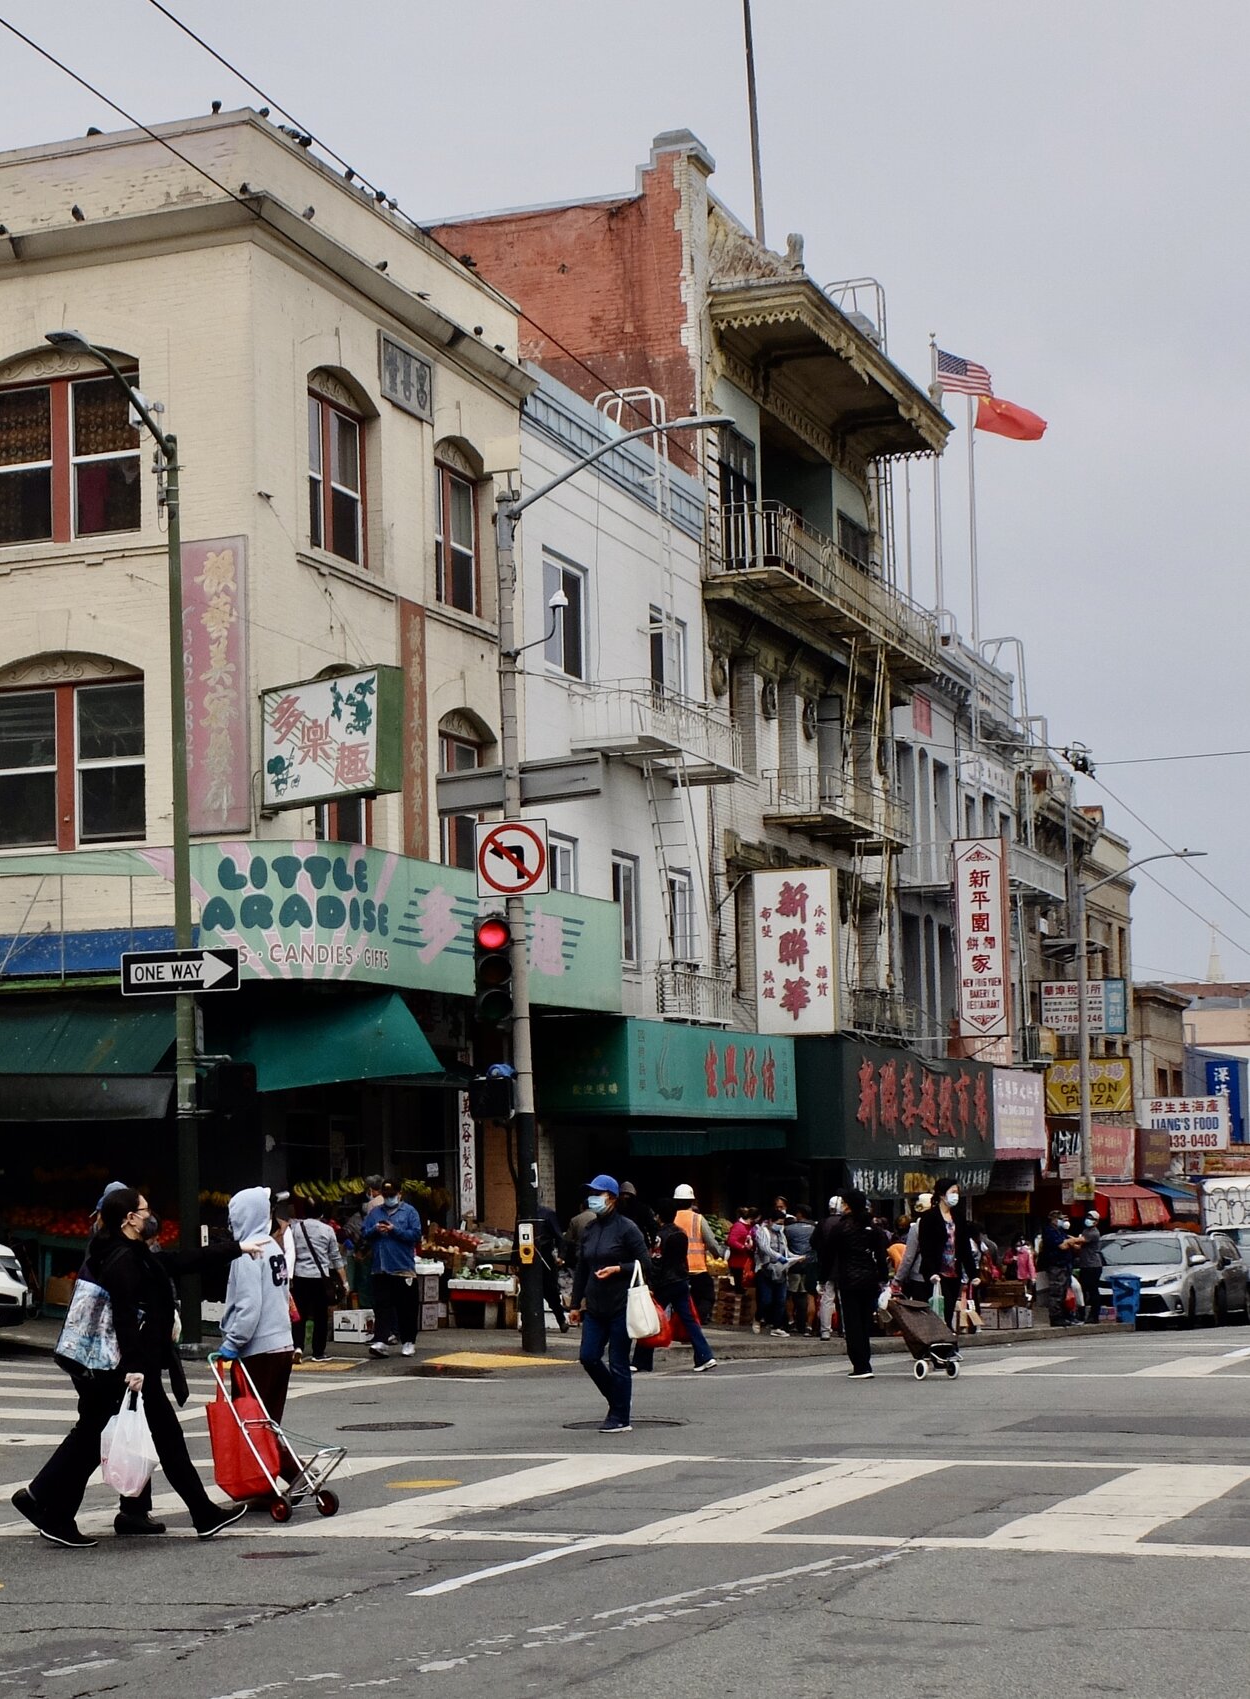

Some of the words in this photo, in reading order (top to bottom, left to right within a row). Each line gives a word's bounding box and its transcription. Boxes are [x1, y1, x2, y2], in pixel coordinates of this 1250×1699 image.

[218, 856, 369, 893] LITTLE
[269, 943, 354, 966] CANDIES
[364, 948, 389, 970] GIFTS
[775, 881, 811, 1021] 新聯華
[134, 965, 165, 982] ONE
[171, 962, 202, 980] WAY
[1044, 983, 1102, 997] 華埠稅所
[1060, 1082, 1118, 1096] CATON
[1194, 1117, 1219, 1131] FOOD
